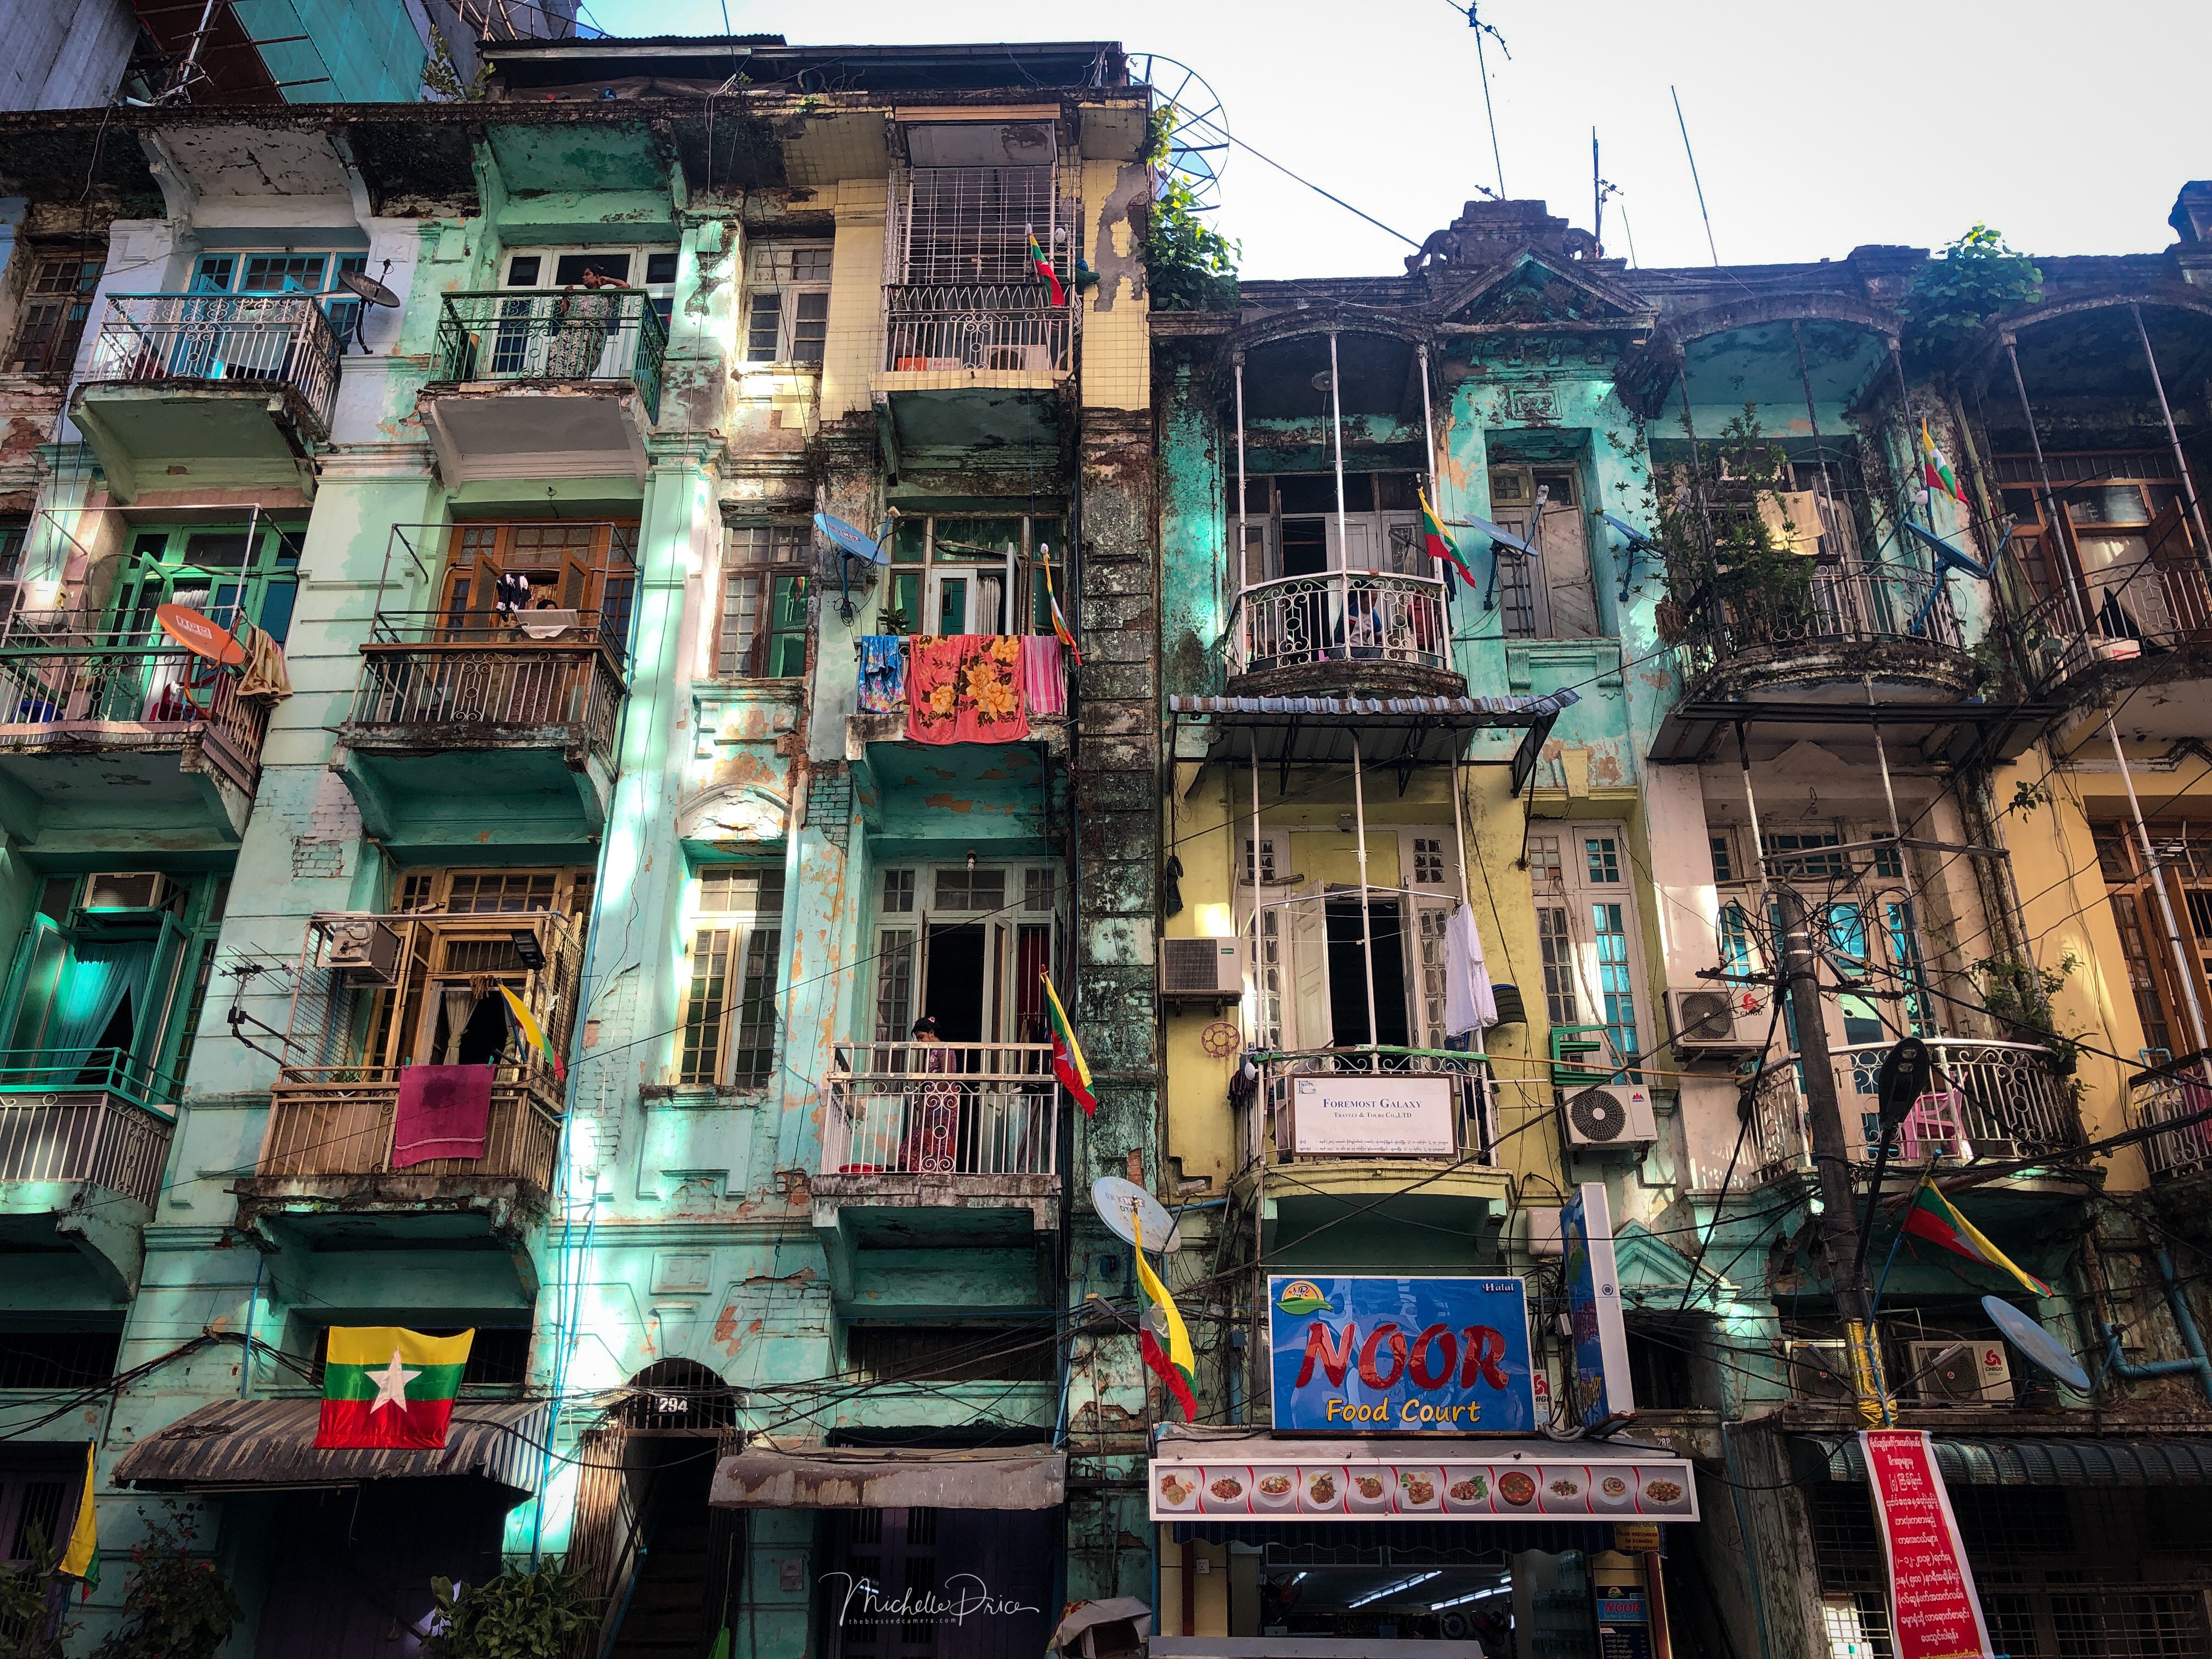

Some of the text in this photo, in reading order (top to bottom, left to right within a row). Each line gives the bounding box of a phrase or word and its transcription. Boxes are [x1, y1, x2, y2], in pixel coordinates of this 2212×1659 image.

[1323, 1098, 1422, 1108] FOREMOST GALAXY
[1105, 1192, 1146, 1207] SKYNT
[1482, 1282, 1515, 1292] Halal
[1295, 1322, 1510, 1391] NOOR
[658, 1397, 689, 1413] 294
[1327, 1397, 1482, 1423] Food Court
